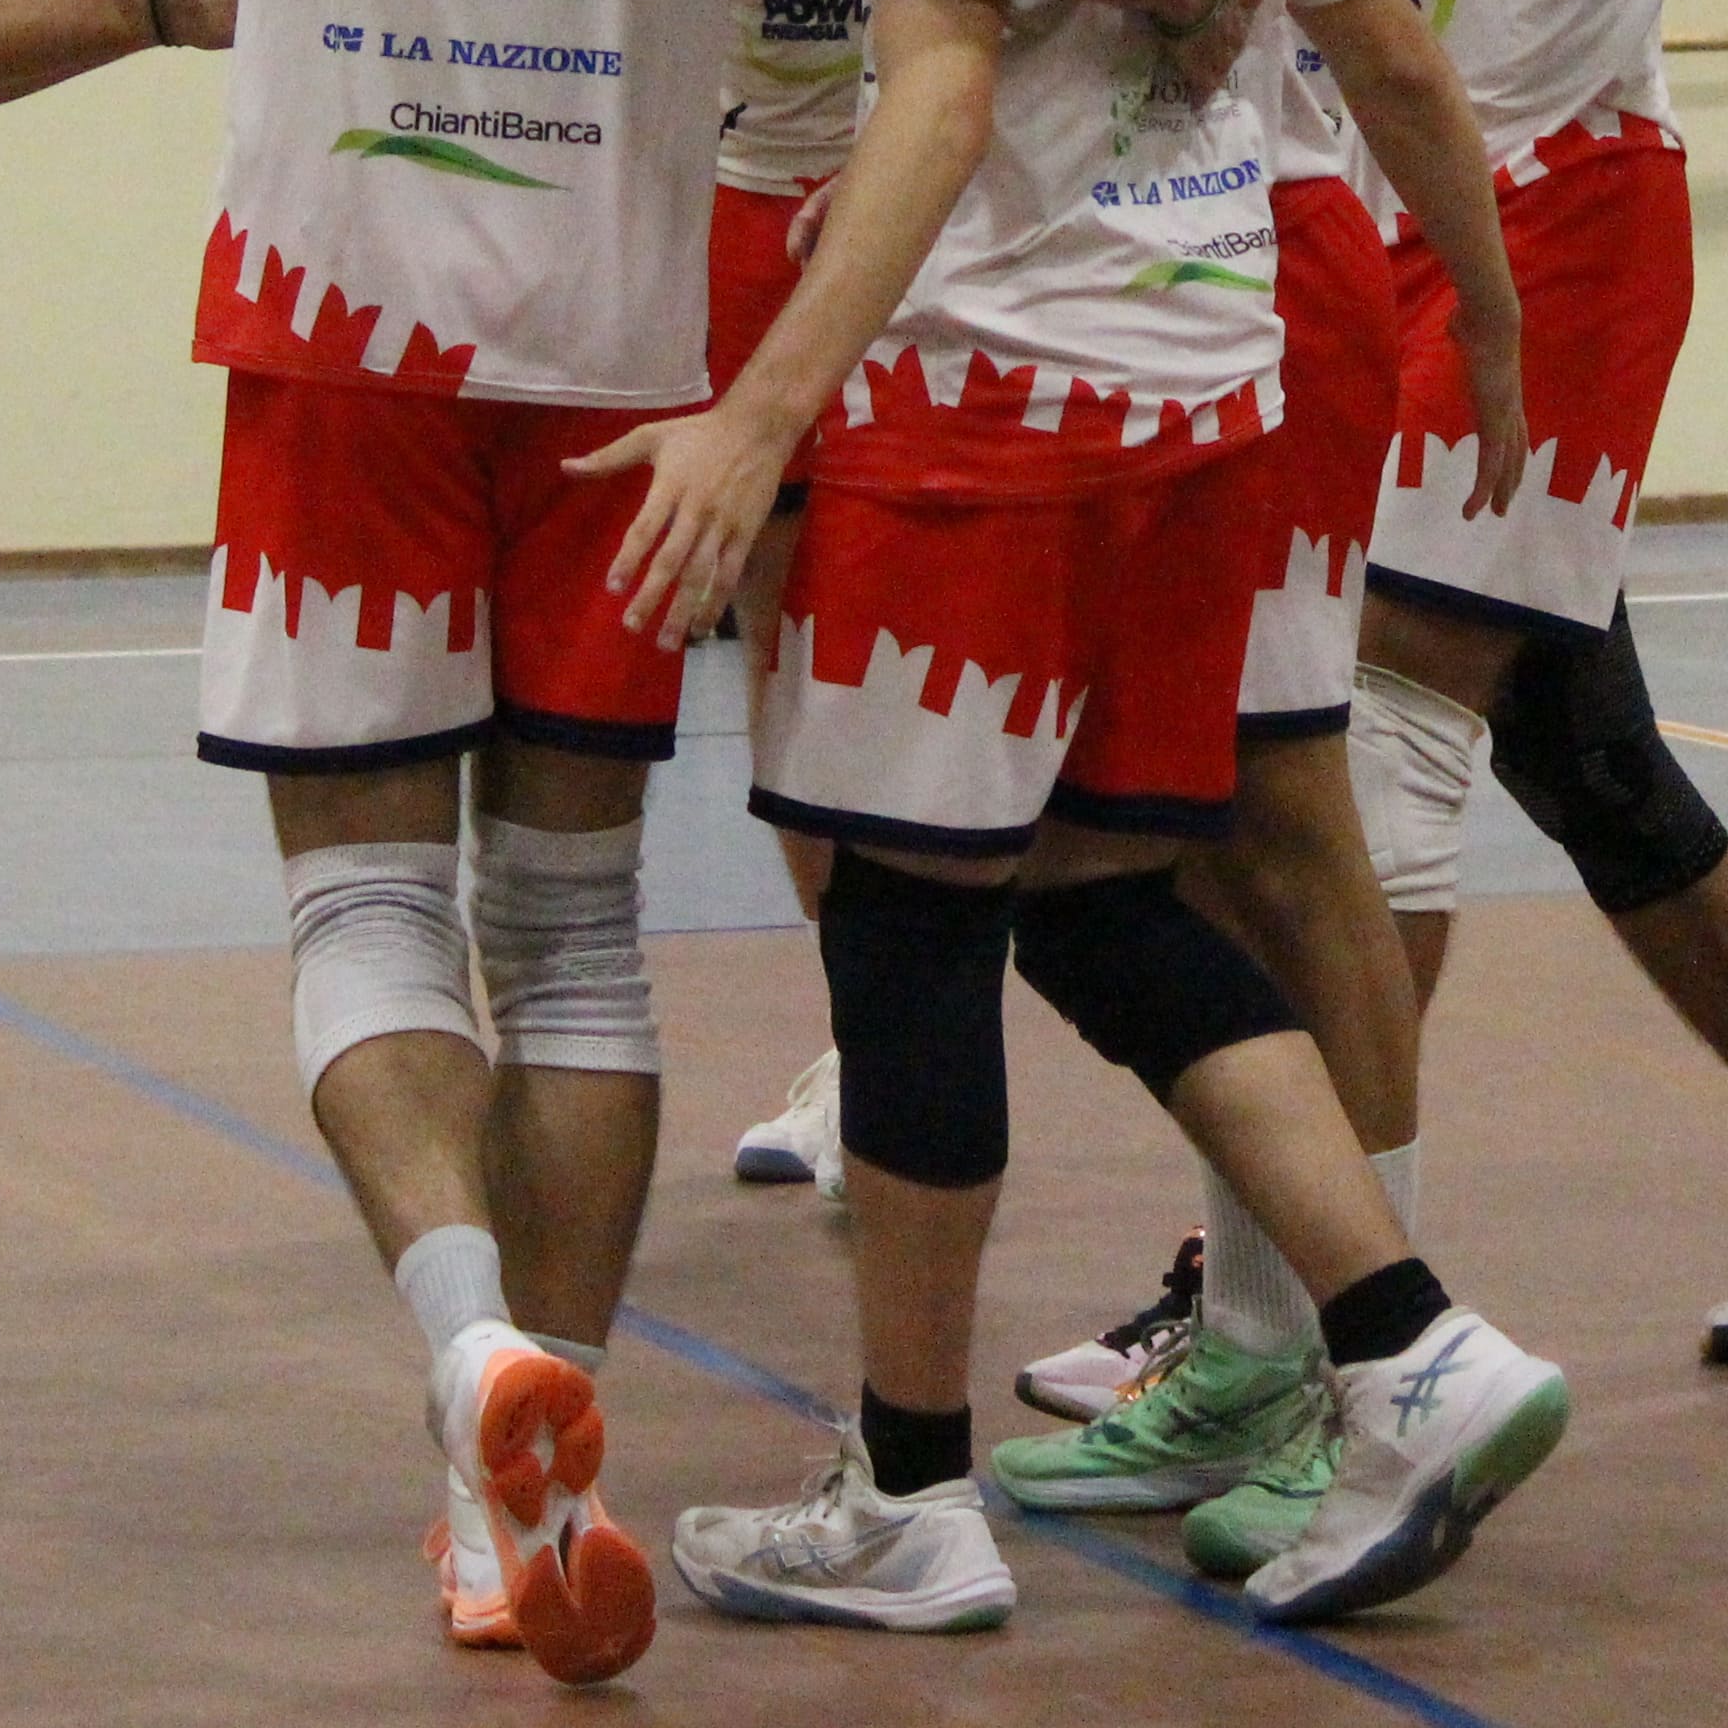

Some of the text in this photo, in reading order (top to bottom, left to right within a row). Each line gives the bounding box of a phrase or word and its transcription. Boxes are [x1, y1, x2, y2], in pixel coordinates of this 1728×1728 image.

[379, 32, 433, 61] LA
[447, 38, 622, 77] NAZIONE
[389, 102, 603, 146] ChiantiBanca
[1127, 181, 1162, 206] LA
[1168, 158, 1262, 202] NAZION
